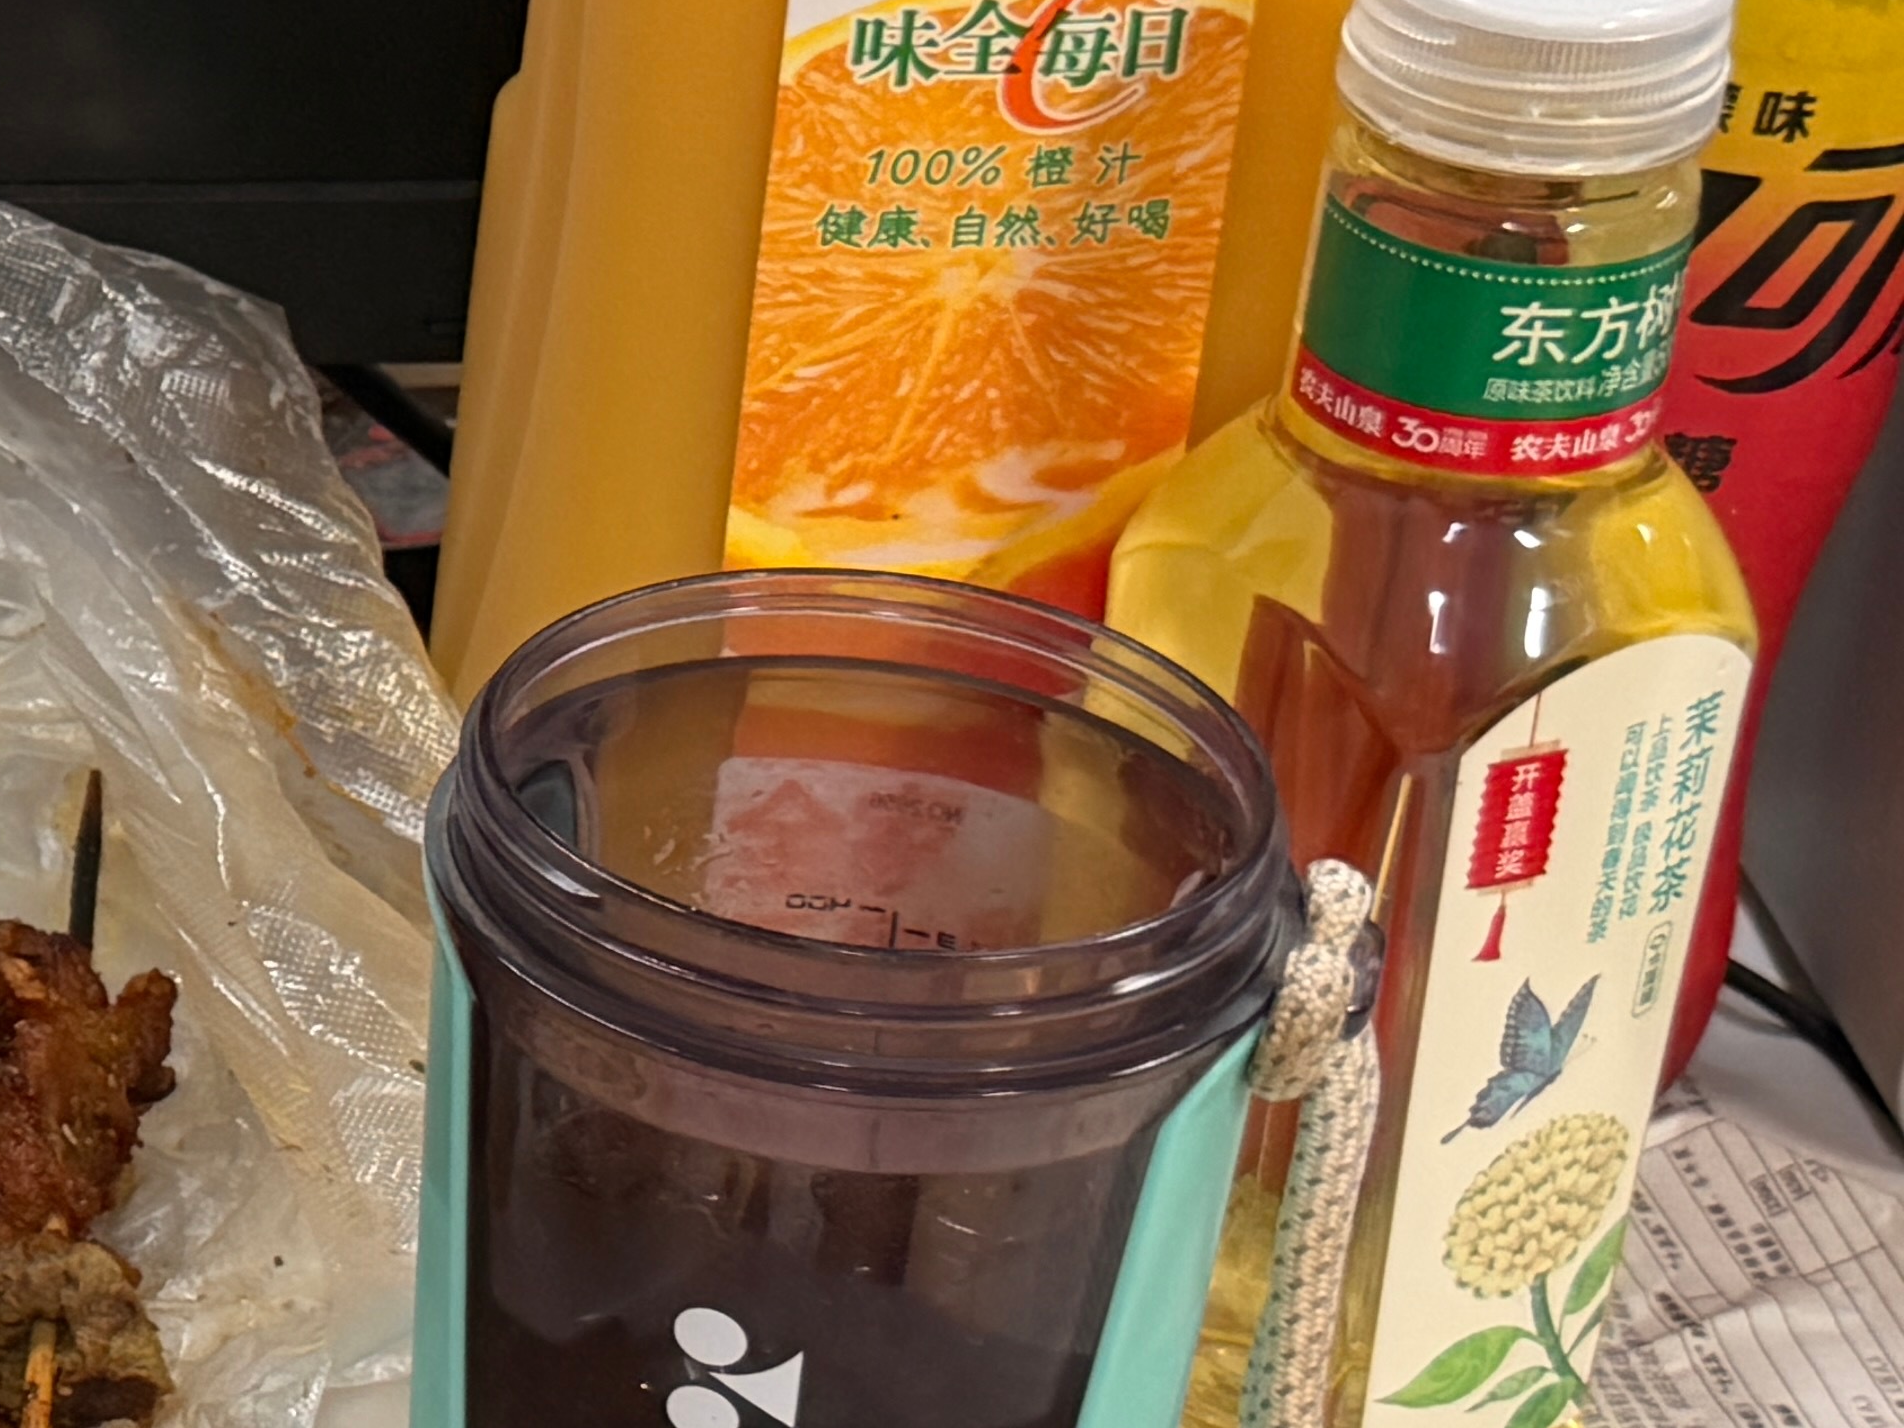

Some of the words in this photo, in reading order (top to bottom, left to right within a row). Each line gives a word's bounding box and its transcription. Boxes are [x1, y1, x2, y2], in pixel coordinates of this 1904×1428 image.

[848, 0, 1190, 89] 味全每日
[864, 144, 1006, 189] 100%
[1297, 368, 1388, 439] 农夫山泉
[1647, 689, 1726, 916] 茉莉花茶
